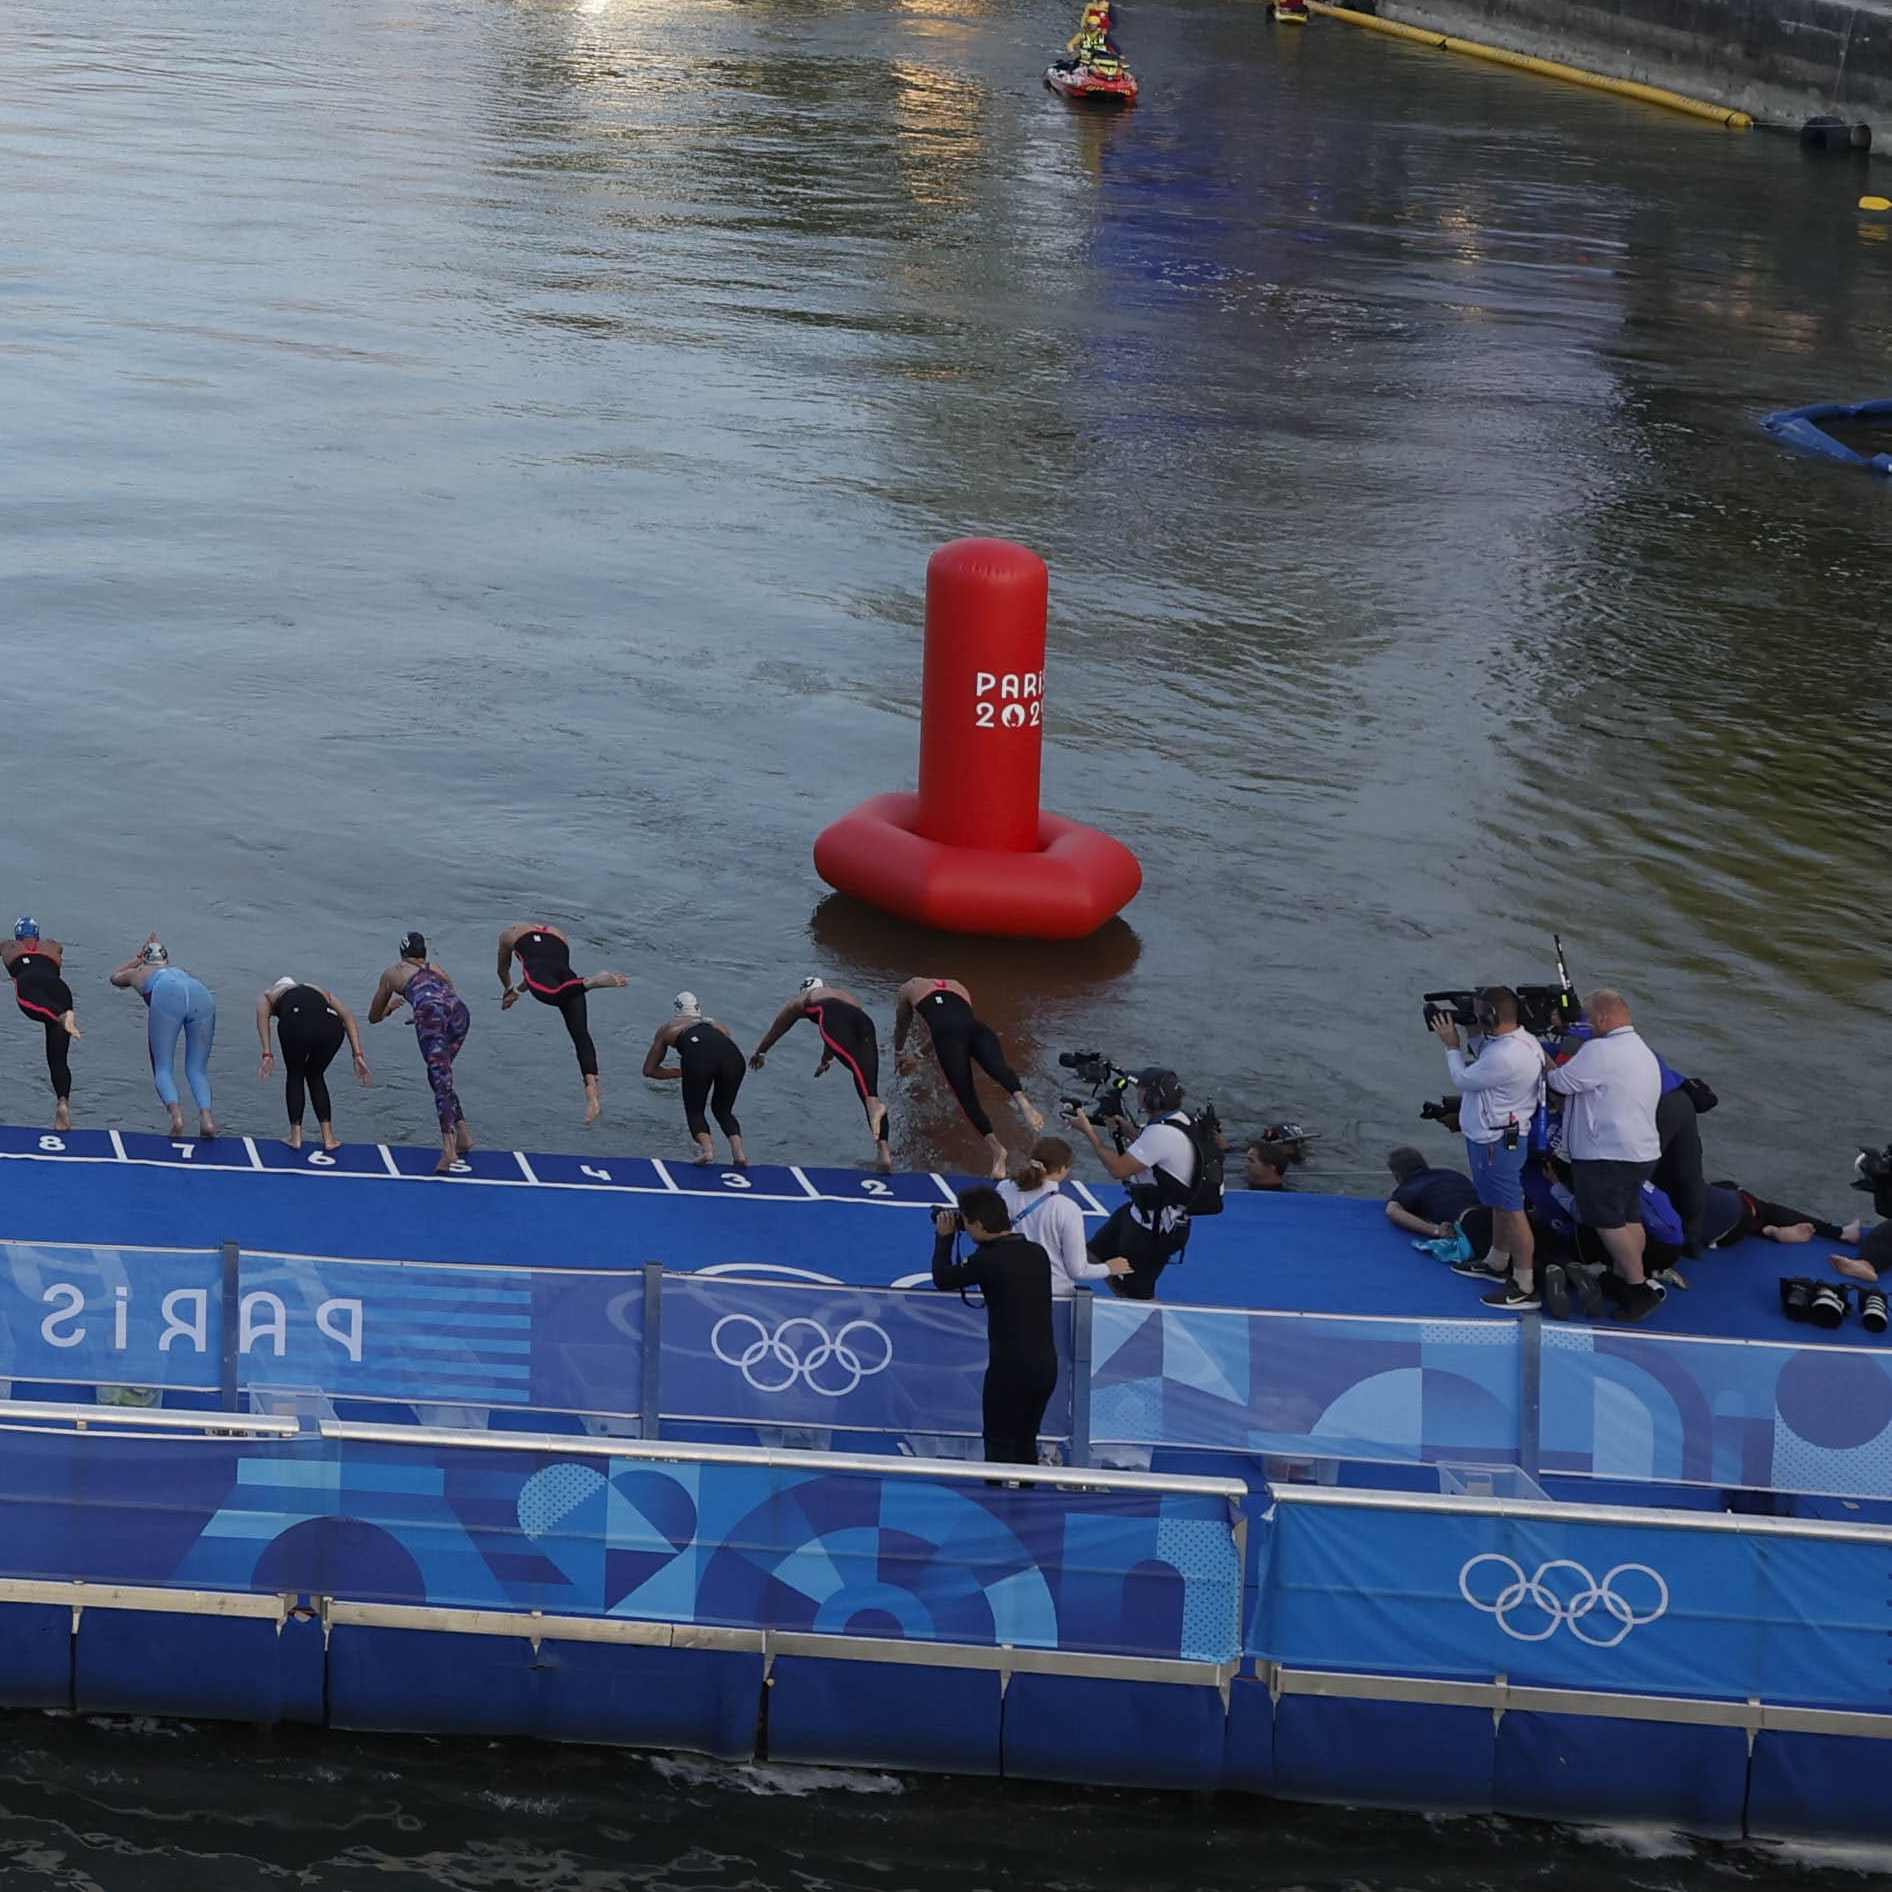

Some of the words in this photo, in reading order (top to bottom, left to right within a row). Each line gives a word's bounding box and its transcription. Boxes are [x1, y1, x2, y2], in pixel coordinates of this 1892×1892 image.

[975, 702, 1044, 729] 202
[39, 1134, 66, 1152] 8
[171, 1142, 196, 1159] 7
[307, 1150, 337, 1166] 6
[580, 1163, 612, 1181] 4
[720, 1171, 752, 1189] 3
[860, 1178, 894, 1196] 2
